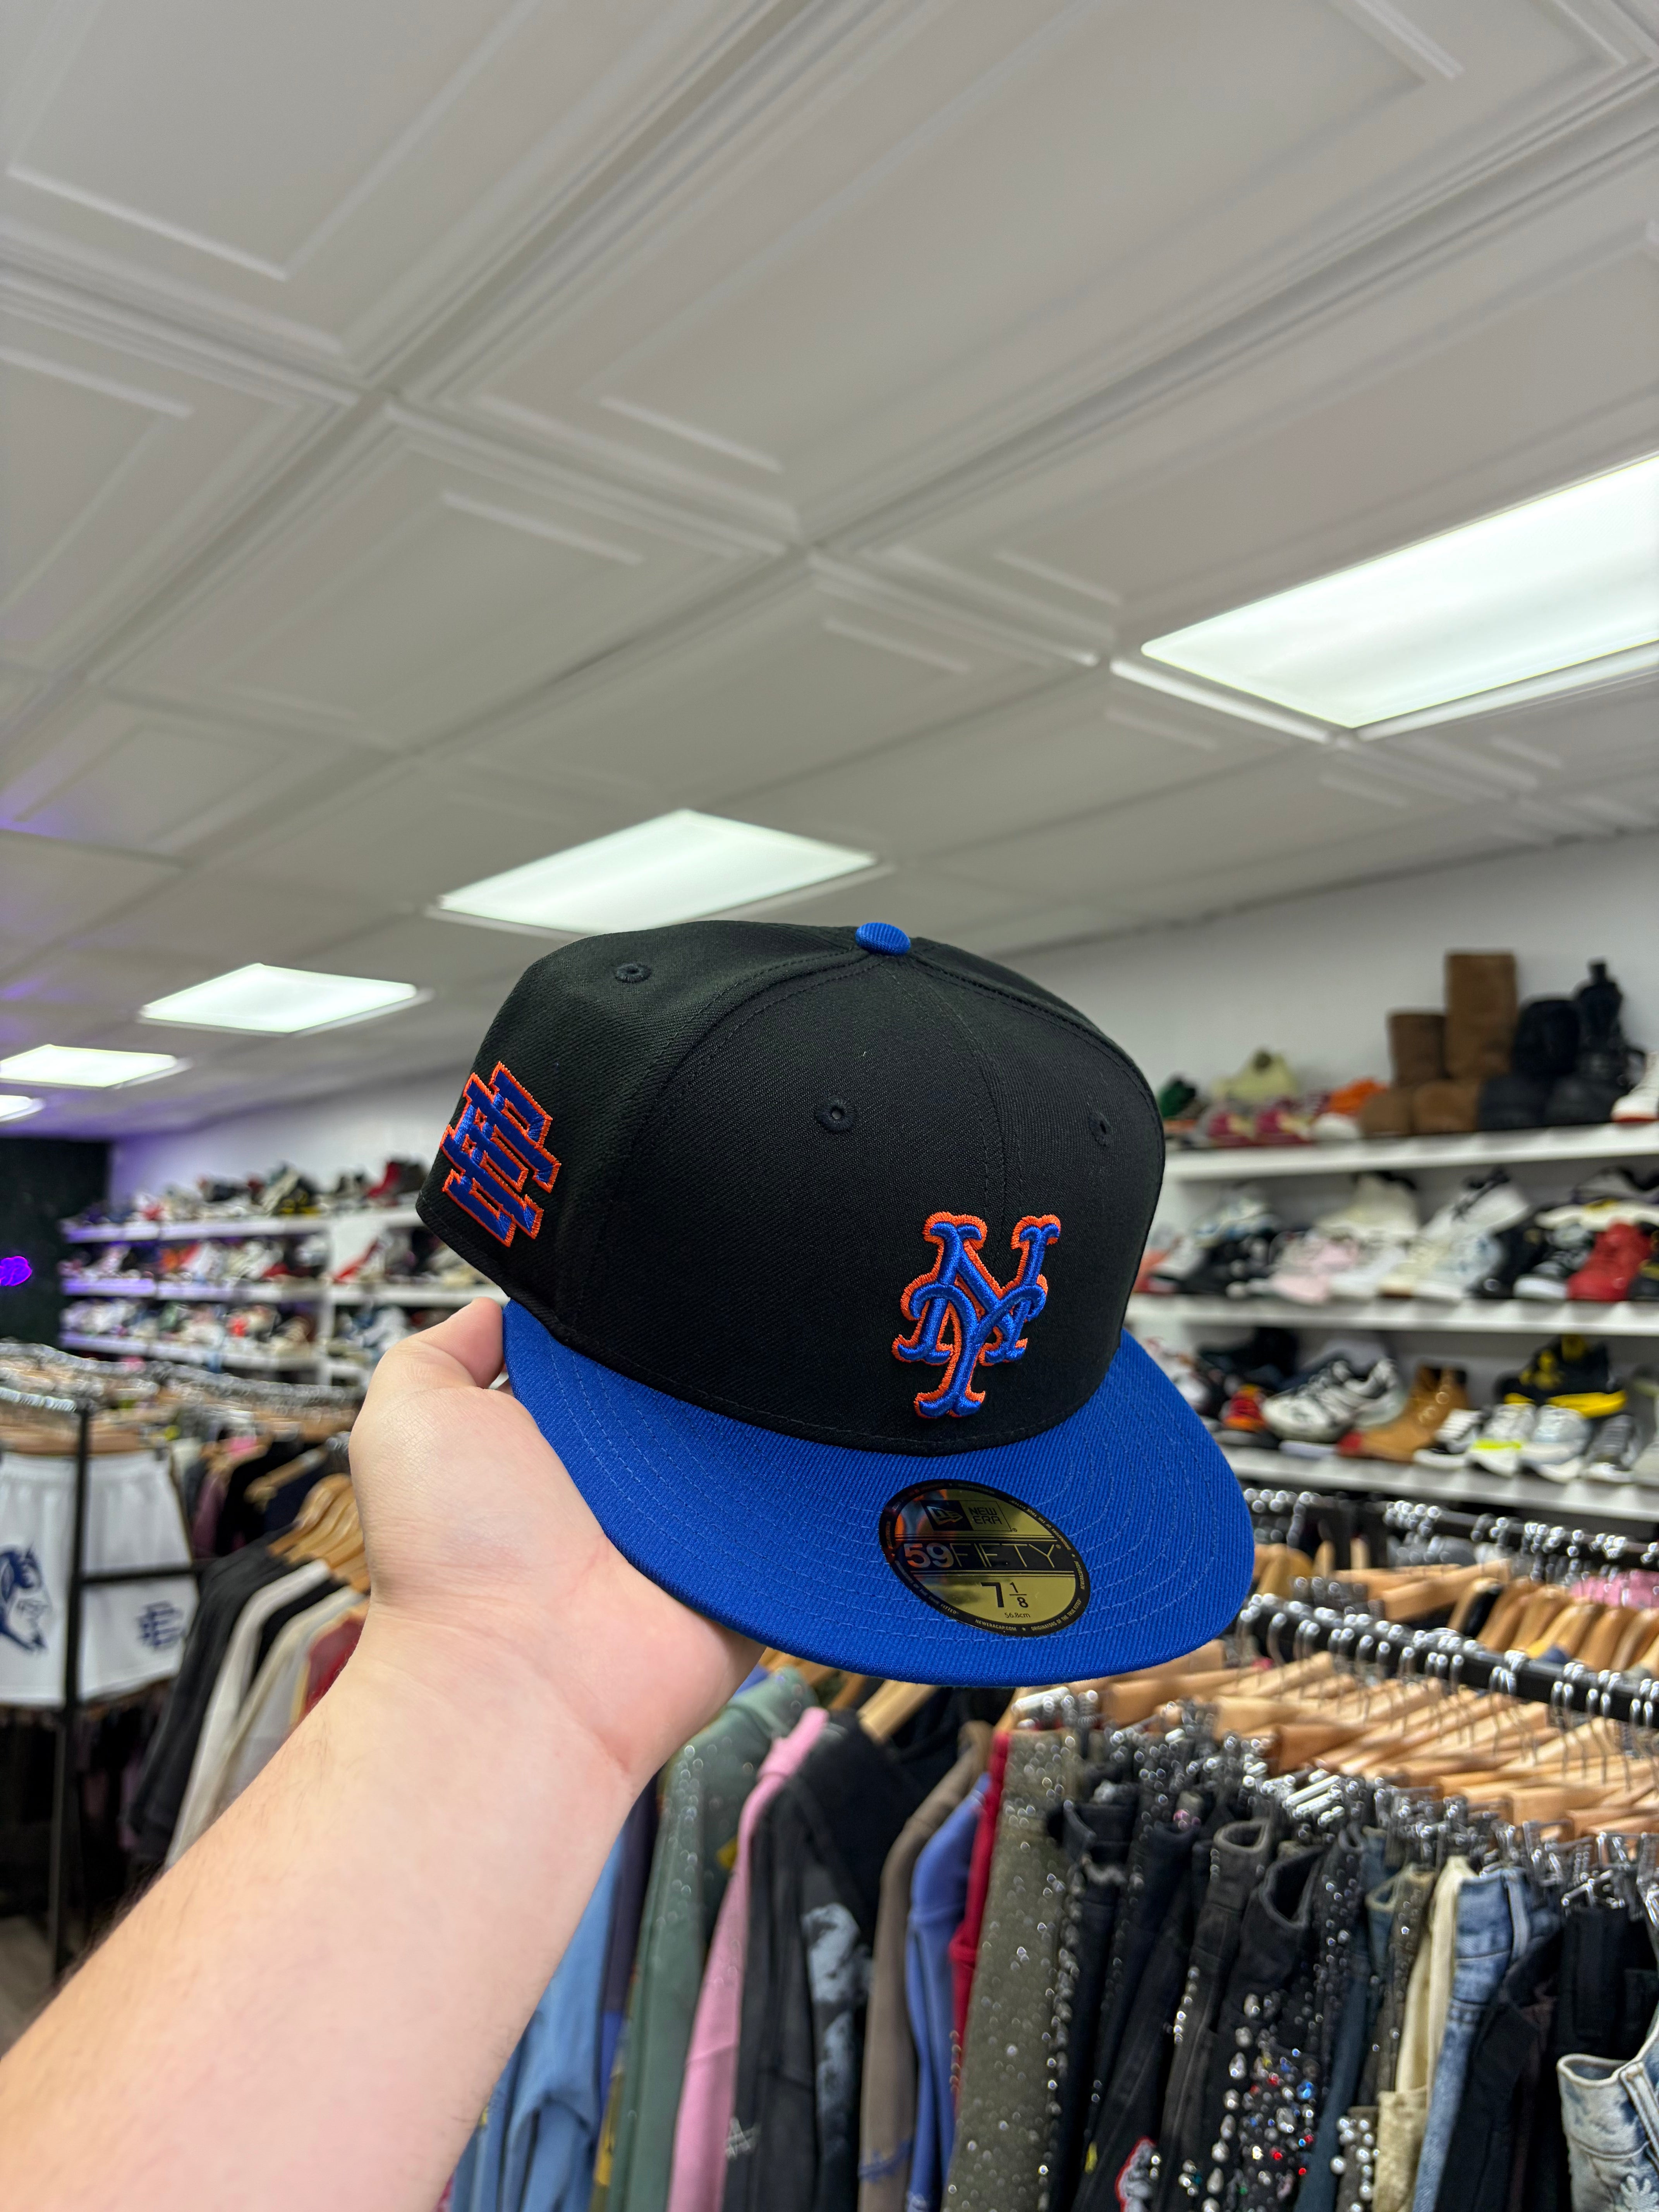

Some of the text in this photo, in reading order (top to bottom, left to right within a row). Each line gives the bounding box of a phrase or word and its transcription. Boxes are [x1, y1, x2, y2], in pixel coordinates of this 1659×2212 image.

[891, 1212, 1060, 1419] NY
[969, 1507, 997, 1515] NEW
[973, 1516, 1002, 1524] ERA
[903, 1542, 1055, 1568] 59FIFTY
[981, 1582, 1004, 1607] 7
[975, 1619, 1017, 1631] NEWERACAP.COM
